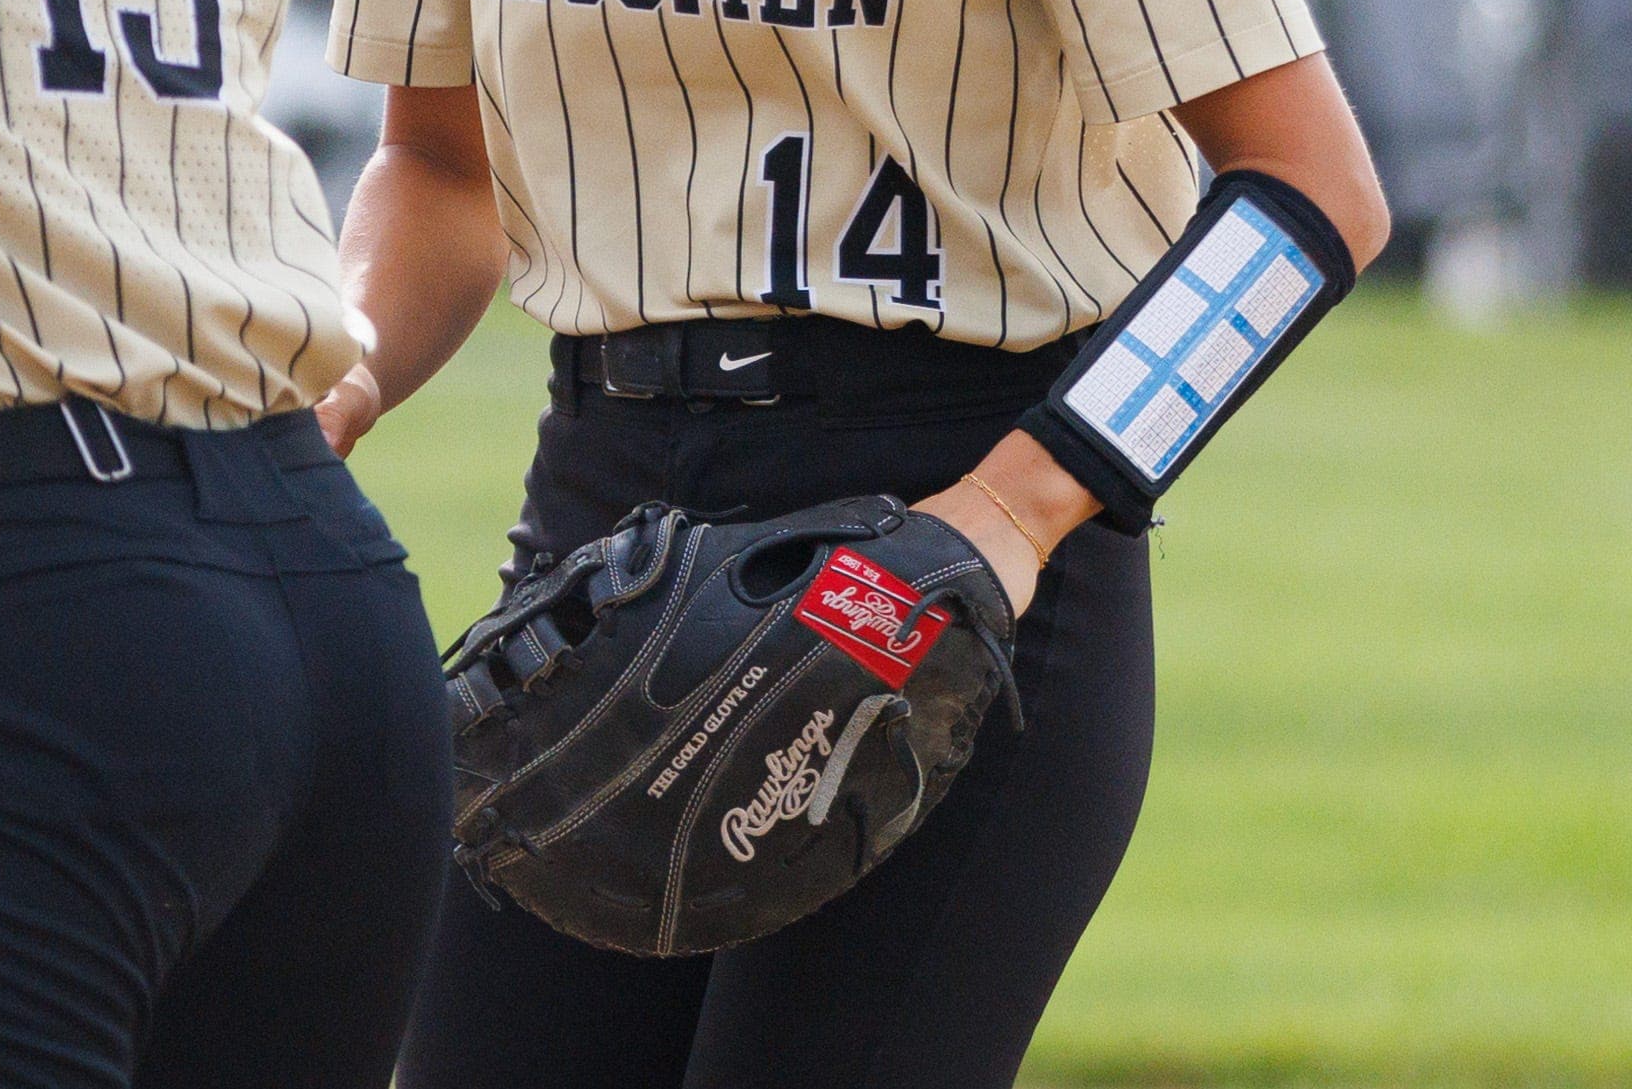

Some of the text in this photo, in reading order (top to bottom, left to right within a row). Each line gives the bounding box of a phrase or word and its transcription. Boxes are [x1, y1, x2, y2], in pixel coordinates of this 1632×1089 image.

[757, 131, 945, 311] 14
[647, 665, 769, 800] THE GOLD GLOVE CO.
[720, 709, 835, 862] Rawlings
